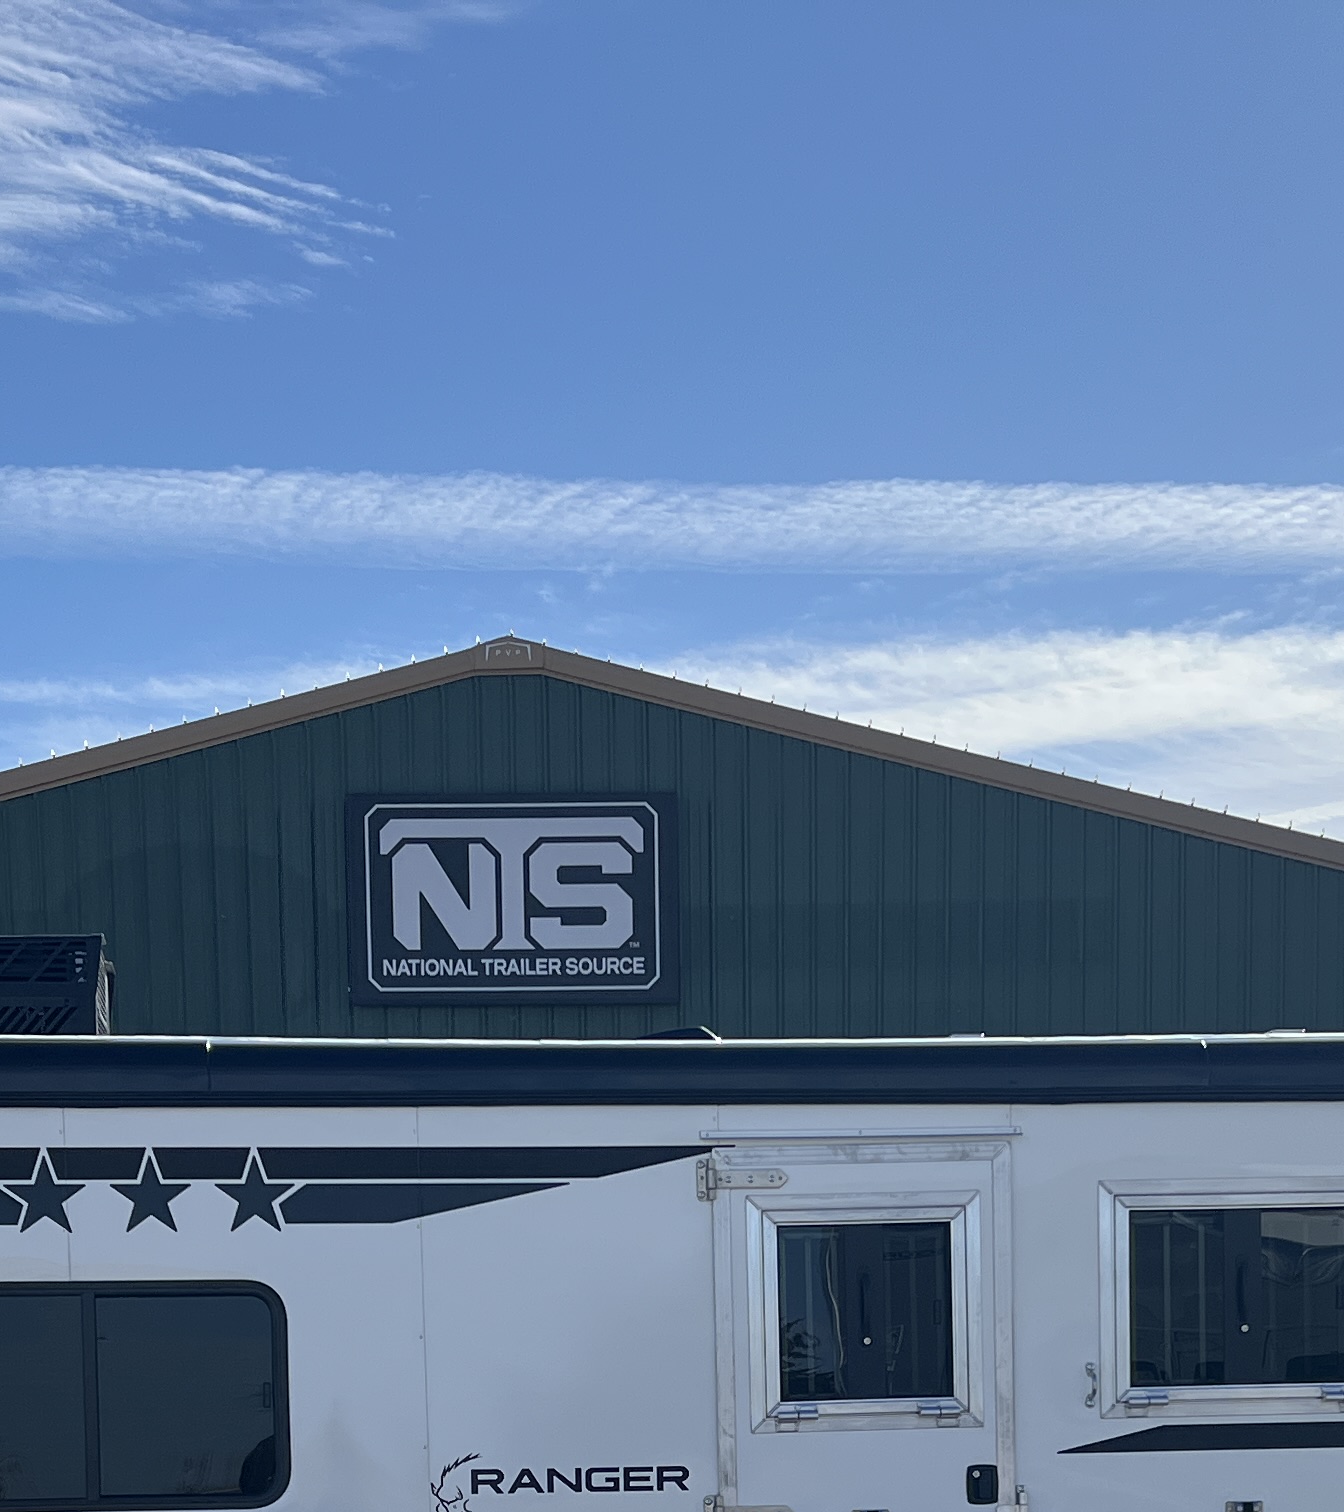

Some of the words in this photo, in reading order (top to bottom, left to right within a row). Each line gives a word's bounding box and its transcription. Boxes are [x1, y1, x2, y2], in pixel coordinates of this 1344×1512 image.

[379, 816, 644, 950] NTS
[382, 958, 478, 977] NATIONAL
[481, 957, 562, 976] TRAILER
[565, 956, 646, 975] SOURCE
[470, 1465, 690, 1495] RANGER
